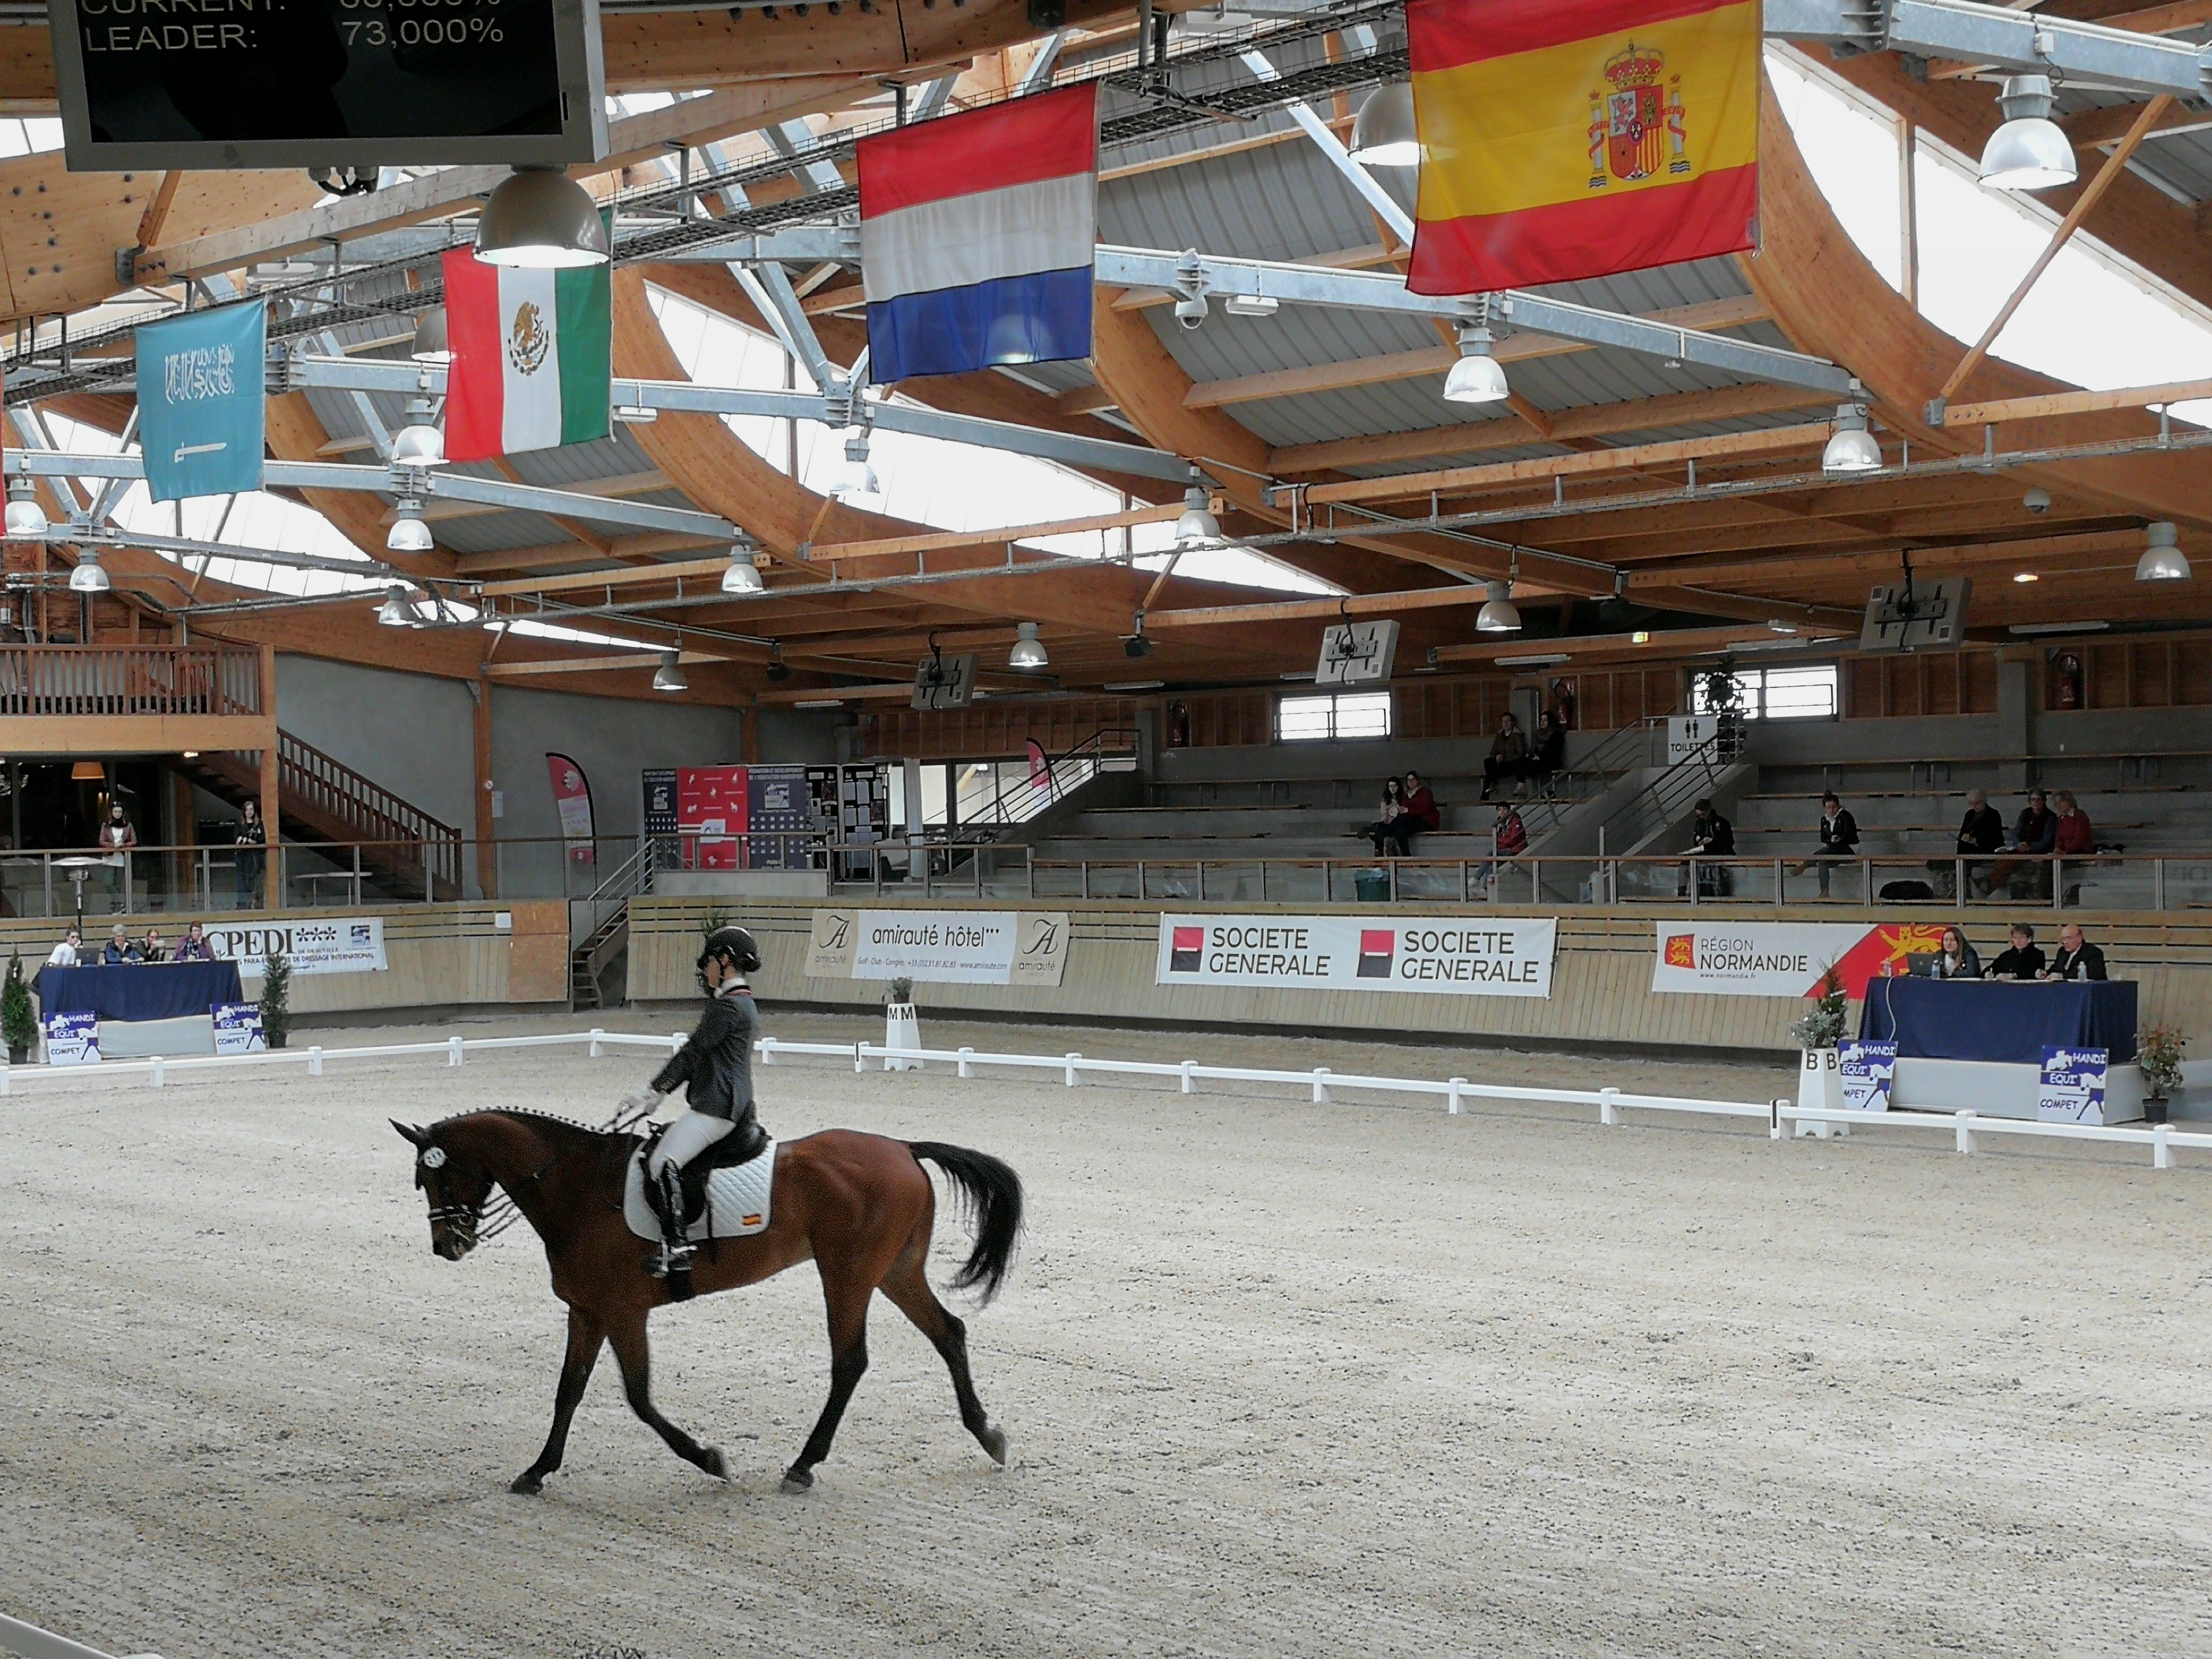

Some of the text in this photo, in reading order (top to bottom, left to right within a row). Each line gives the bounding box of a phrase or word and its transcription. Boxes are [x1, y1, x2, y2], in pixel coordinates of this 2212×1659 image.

[85, 18, 503, 51] LEADER: 73,000%
[1671, 743, 1715, 751] TOILETS
[872, 924, 938, 945] amirauté
[1212, 927, 1309, 949] SOCIETE
[1404, 930, 1514, 954] SOCIETE
[1701, 935, 1753, 951] RÉGION
[1209, 953, 1331, 976] GENERALE
[1700, 954, 1807, 972] NORMANDIE
[1401, 958, 1539, 982] GENERALE
[234, 1005, 259, 1013] HANDI
[889, 1006, 913, 1020] M M
[69, 1014, 95, 1022] HANDI
[54, 1030, 75, 1039] EQUI
[1865, 1045, 1896, 1056] HANDI
[1806, 1052, 1836, 1070] B B
[2073, 1052, 2106, 1064] HANDI
[1842, 1065, 1868, 1076] EQUI
[2049, 1073, 2078, 1085] EQUI
[1844, 1089, 1866, 1099] MPET
[2040, 1099, 2078, 1109] COMPET
